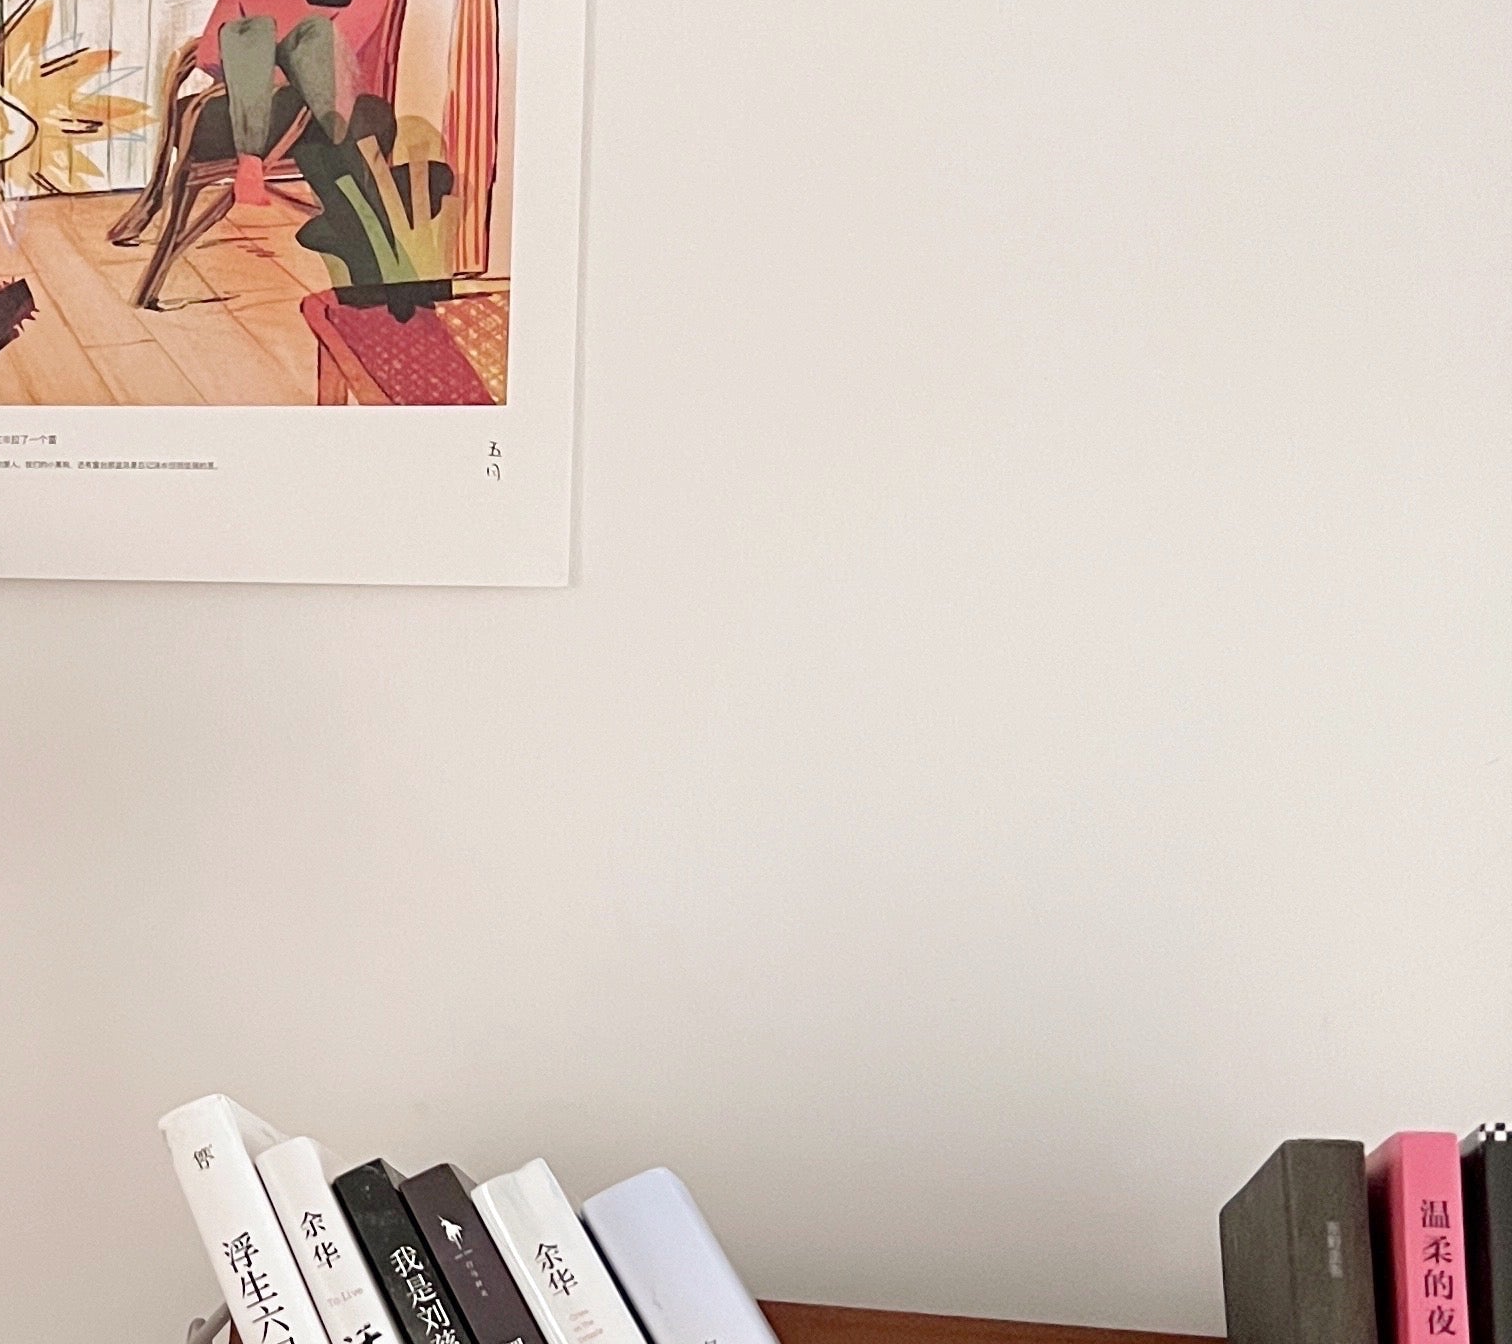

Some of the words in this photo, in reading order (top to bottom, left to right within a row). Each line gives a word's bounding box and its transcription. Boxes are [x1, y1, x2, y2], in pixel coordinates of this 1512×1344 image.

[300, 1211, 341, 1269] 余华
[1420, 1199, 1457, 1336] 温柔的夜
[535, 1243, 579, 1296] 余华
